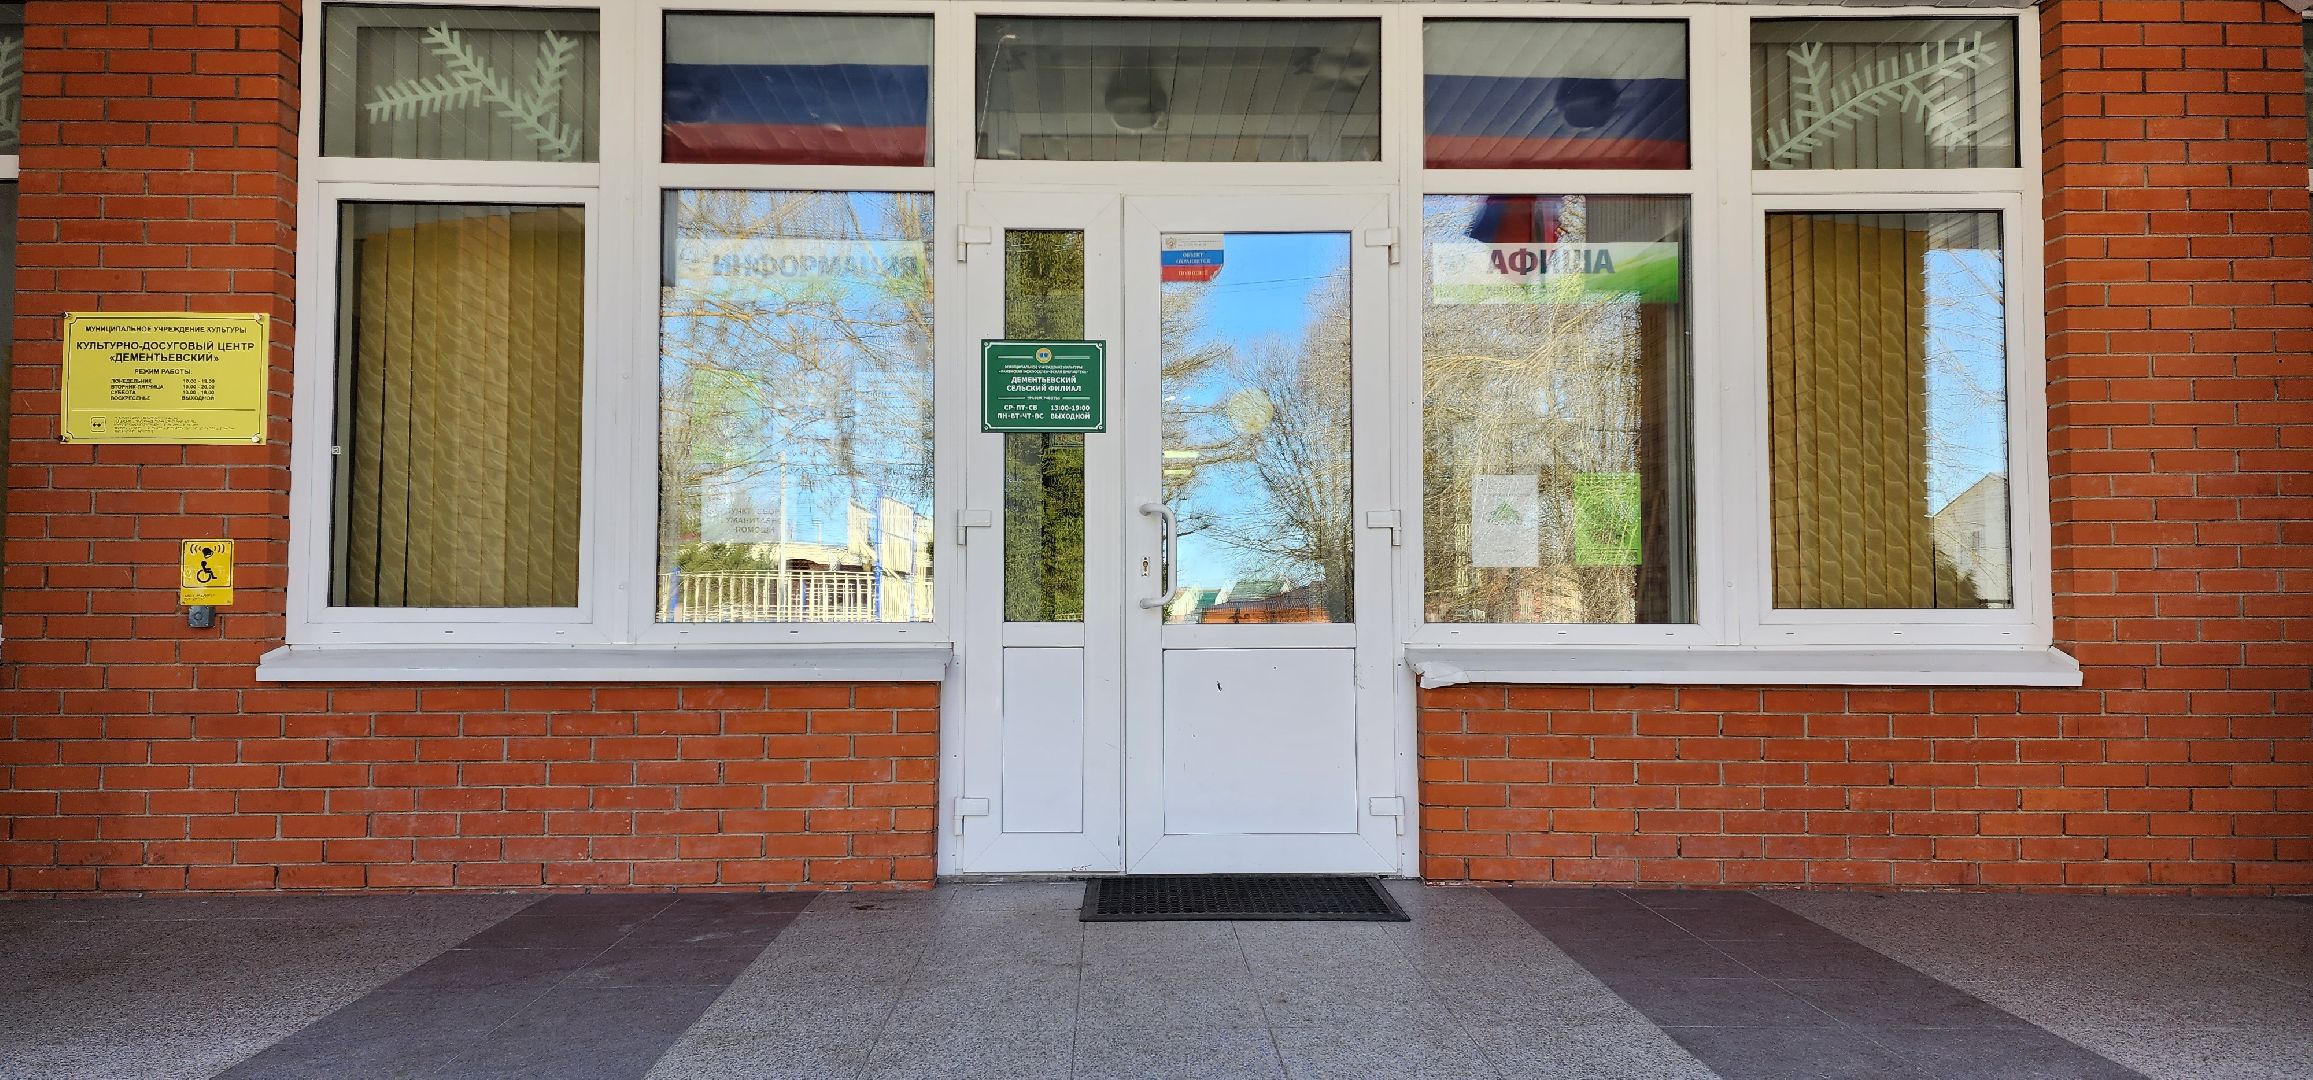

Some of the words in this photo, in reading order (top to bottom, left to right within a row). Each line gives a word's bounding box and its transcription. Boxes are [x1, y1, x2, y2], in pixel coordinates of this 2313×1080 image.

[1487, 248, 1616, 275] АФИША
[85, 325, 151, 334] МУНИЦИПАЛЬНОЕ
[76, 340, 214, 351] КУЛЬТУРНО-ДОСУГОВЫЙ
[217, 342, 255, 352] ЦЕНТР
[109, 352, 220, 362] «ДЕМЕНТЬЕВСКИЙ»
[1010, 375, 1077, 384] ДЕМЕНТЬЕВСКИЙ
[1006, 383, 1047, 392] СЕЛЬСКИЙ
[1050, 411, 1091, 420] ВЫХОДНОЙ
